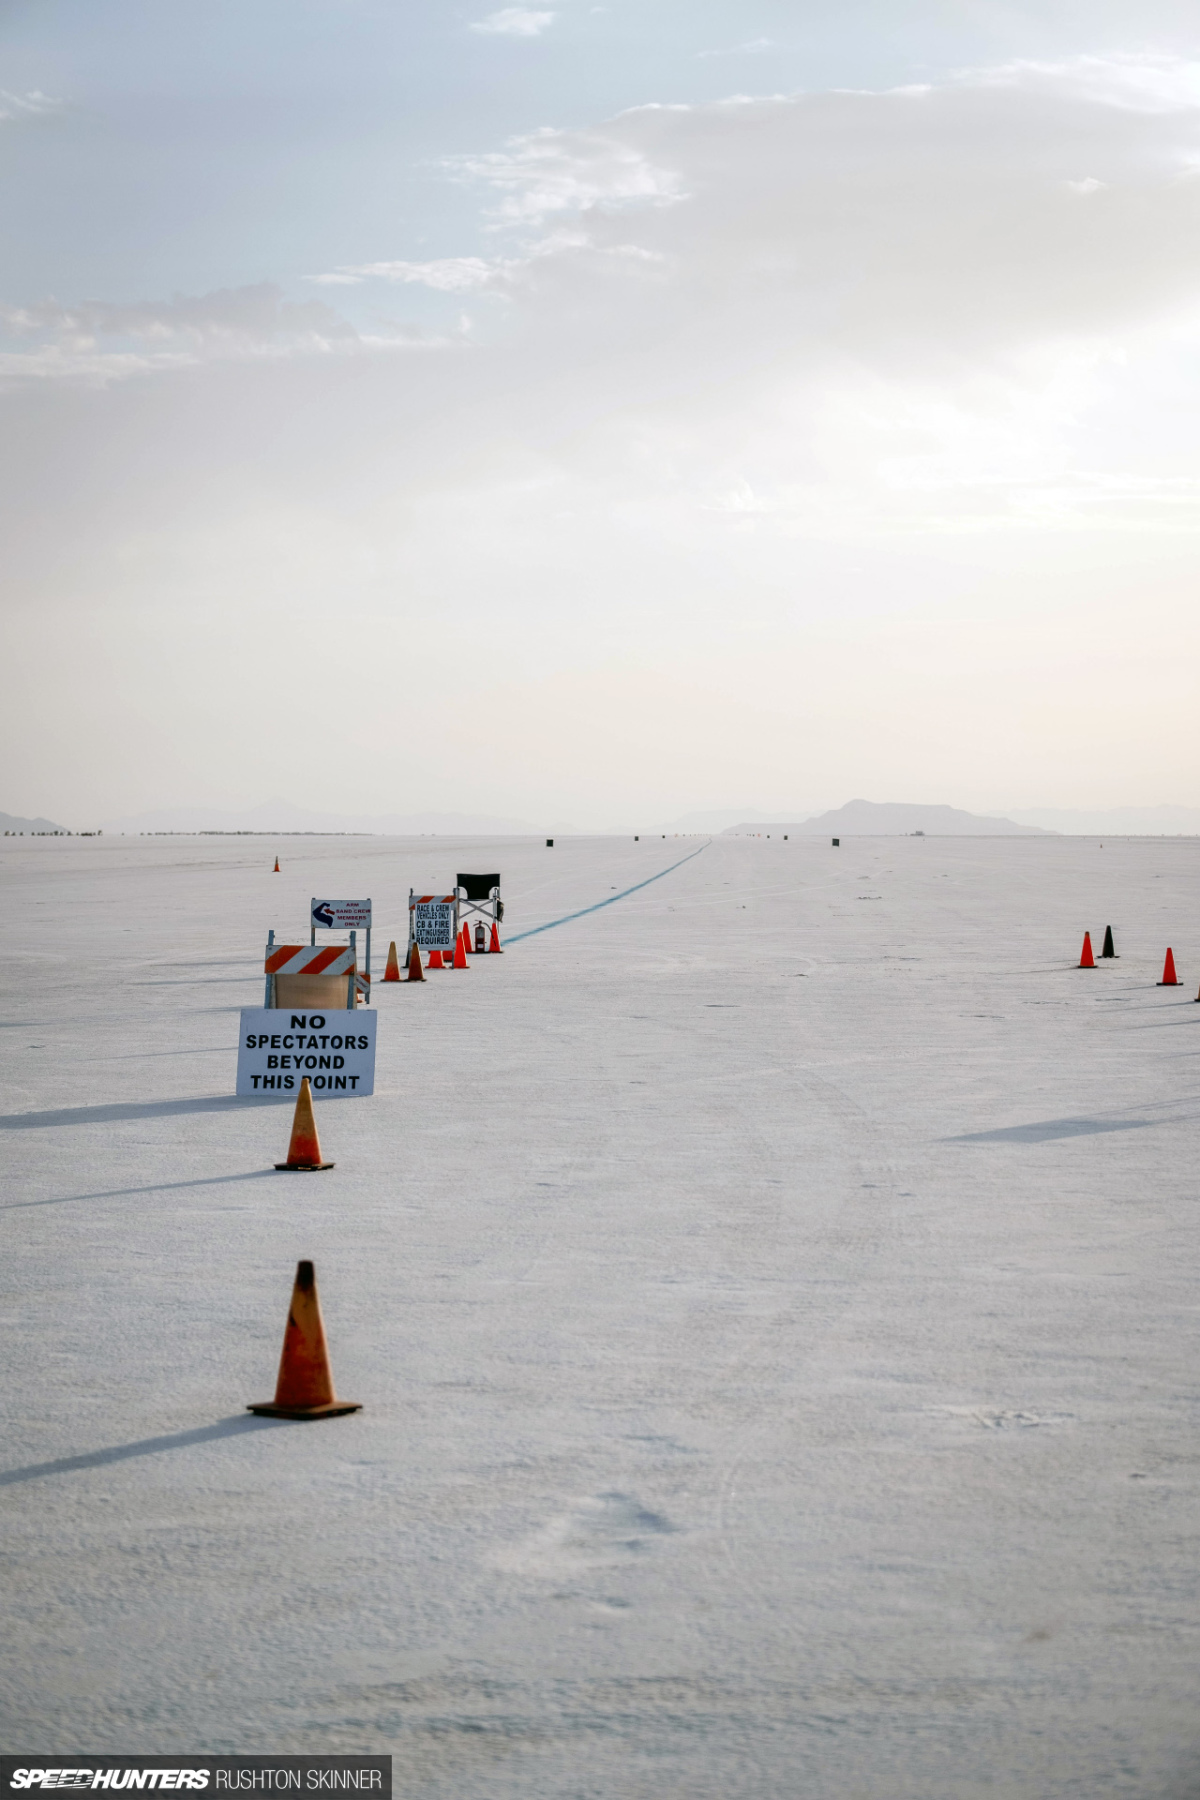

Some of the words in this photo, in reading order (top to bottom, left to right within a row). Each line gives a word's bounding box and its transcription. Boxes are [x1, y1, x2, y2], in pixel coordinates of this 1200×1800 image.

[290, 1015, 326, 1029] NO
[246, 1035, 368, 1049] SPECTATORS
[267, 1055, 344, 1069] BEYOND
[250, 1075, 294, 1089] THIS
